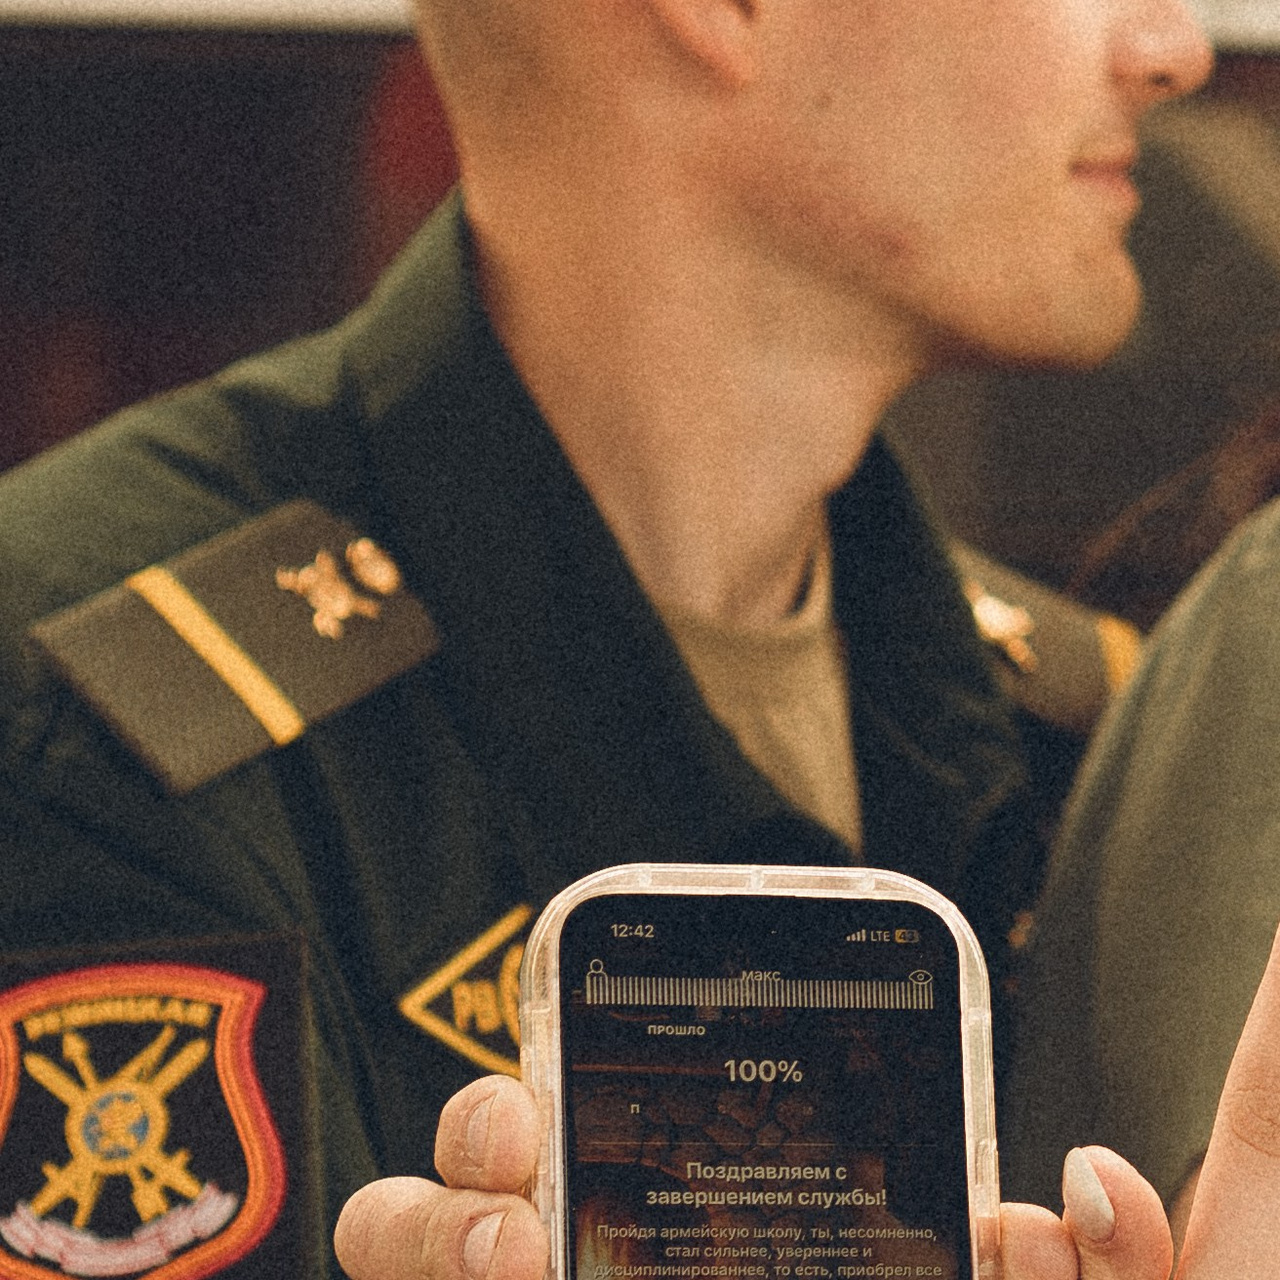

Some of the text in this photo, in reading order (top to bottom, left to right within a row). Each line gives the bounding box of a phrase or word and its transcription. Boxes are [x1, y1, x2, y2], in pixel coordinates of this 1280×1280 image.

[611, 924, 654, 938] 12:42
[871, 931, 890, 941] LTE
[742, 971, 781, 981] макс
[647, 1025, 705, 1036] прошло
[724, 1059, 802, 1083] 100%
[687, 1162, 846, 1182] Поздравляем с
[647, 1189, 886, 1208] завершением службы!
[598, 1225, 936, 1242] Пройдя армейскую школу, ты, несомненно,
[665, 1246, 872, 1260] стал сильнее, увереннее и
[594, 1264, 942, 1279] дисциплинированнее, то есть, приобрел все
